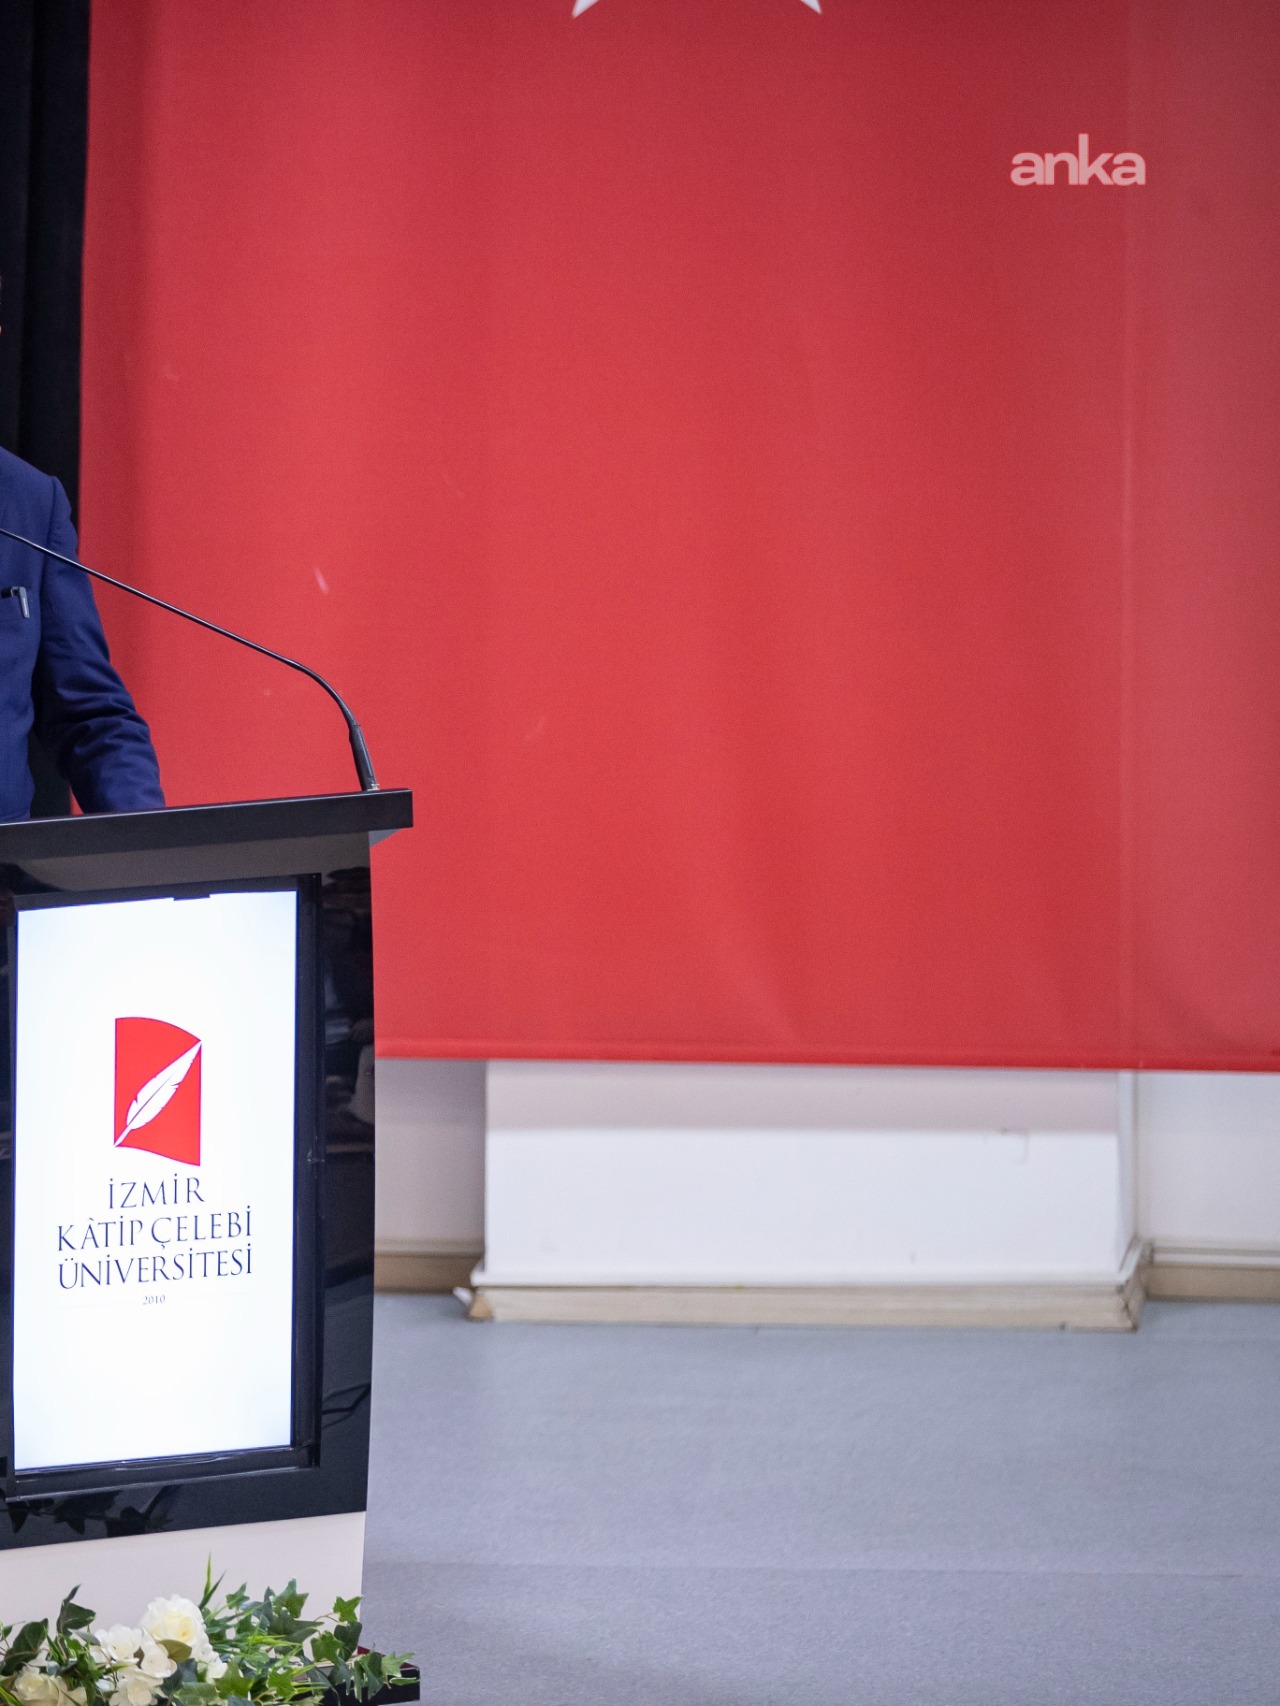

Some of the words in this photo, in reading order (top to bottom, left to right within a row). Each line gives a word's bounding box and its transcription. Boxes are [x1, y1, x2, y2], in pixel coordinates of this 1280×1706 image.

[108, 1173, 206, 1210] İZMİR
[58, 1215, 144, 1252] KÂTİP
[150, 1205, 252, 1250] ÇELEBİ
[58, 1243, 252, 1290] ÜNİVERSİTESİ
[142, 1294, 166, 1305] 2010
